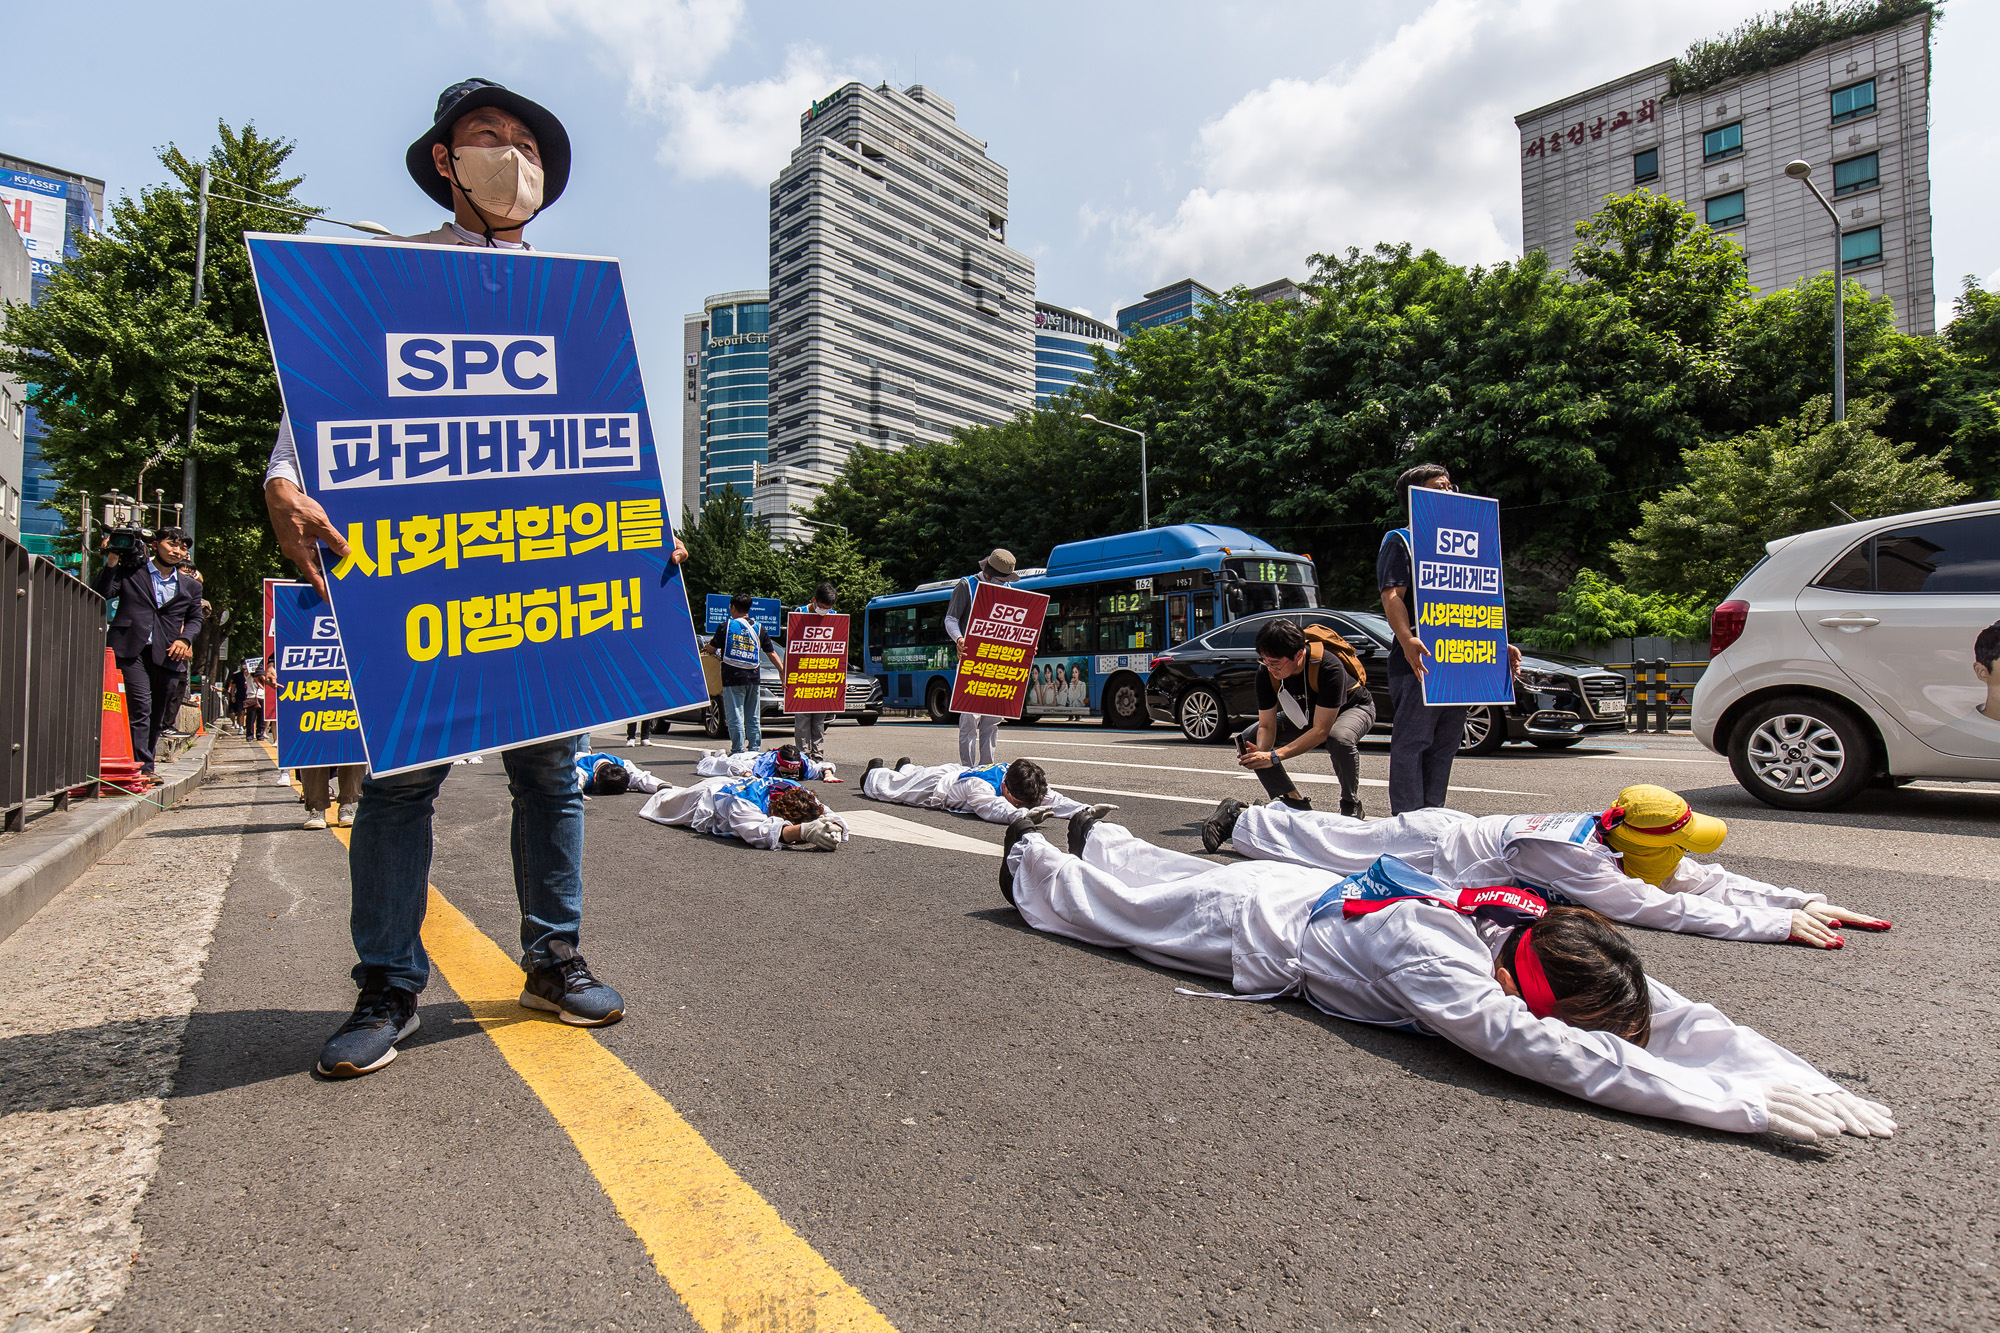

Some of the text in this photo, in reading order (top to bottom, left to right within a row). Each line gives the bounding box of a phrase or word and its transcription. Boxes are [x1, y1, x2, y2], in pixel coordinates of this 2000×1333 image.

[1526, 99, 1655, 157] 서울성남교회
[14, 175, 27, 184] KS
[29, 178, 62, 191] ASSET
[1048, 316, 1061, 326] LG
[710, 332, 769, 348] Seoul Cit
[396, 338, 549, 392] SPC
[688, 368, 696, 402] 티머니
[328, 417, 634, 484] 파리바게뜨
[330, 498, 664, 580] 사회적합의를
[1438, 530, 1476, 556] SPC
[1258, 562, 1288, 582] 162
[1422, 563, 1497, 592] 파리바게뜨
[1136, 580, 1150, 589] 162
[1109, 594, 1140, 612] 162
[406, 578, 643, 662] 이행하라!
[992, 605, 1024, 622] SPC
[1419, 602, 1504, 629] 사회적합의를
[805, 628, 832, 638] SPC
[972, 620, 1036, 644] 파리바게뜨
[285, 648, 346, 668] 파리
[791, 642, 844, 654] 파리바게뜨
[976, 642, 1026, 663] 불법행위
[1435, 638, 1496, 664] 이행하라!
[798, 658, 840, 670] 불법행위
[960, 660, 1028, 682] 윤석열정부가
[788, 672, 846, 684] 윤석열정부가
[278, 680, 354, 701] 사회적
[794, 687, 838, 698] 처벌하라!
[964, 680, 1018, 700] 처벌하라!
